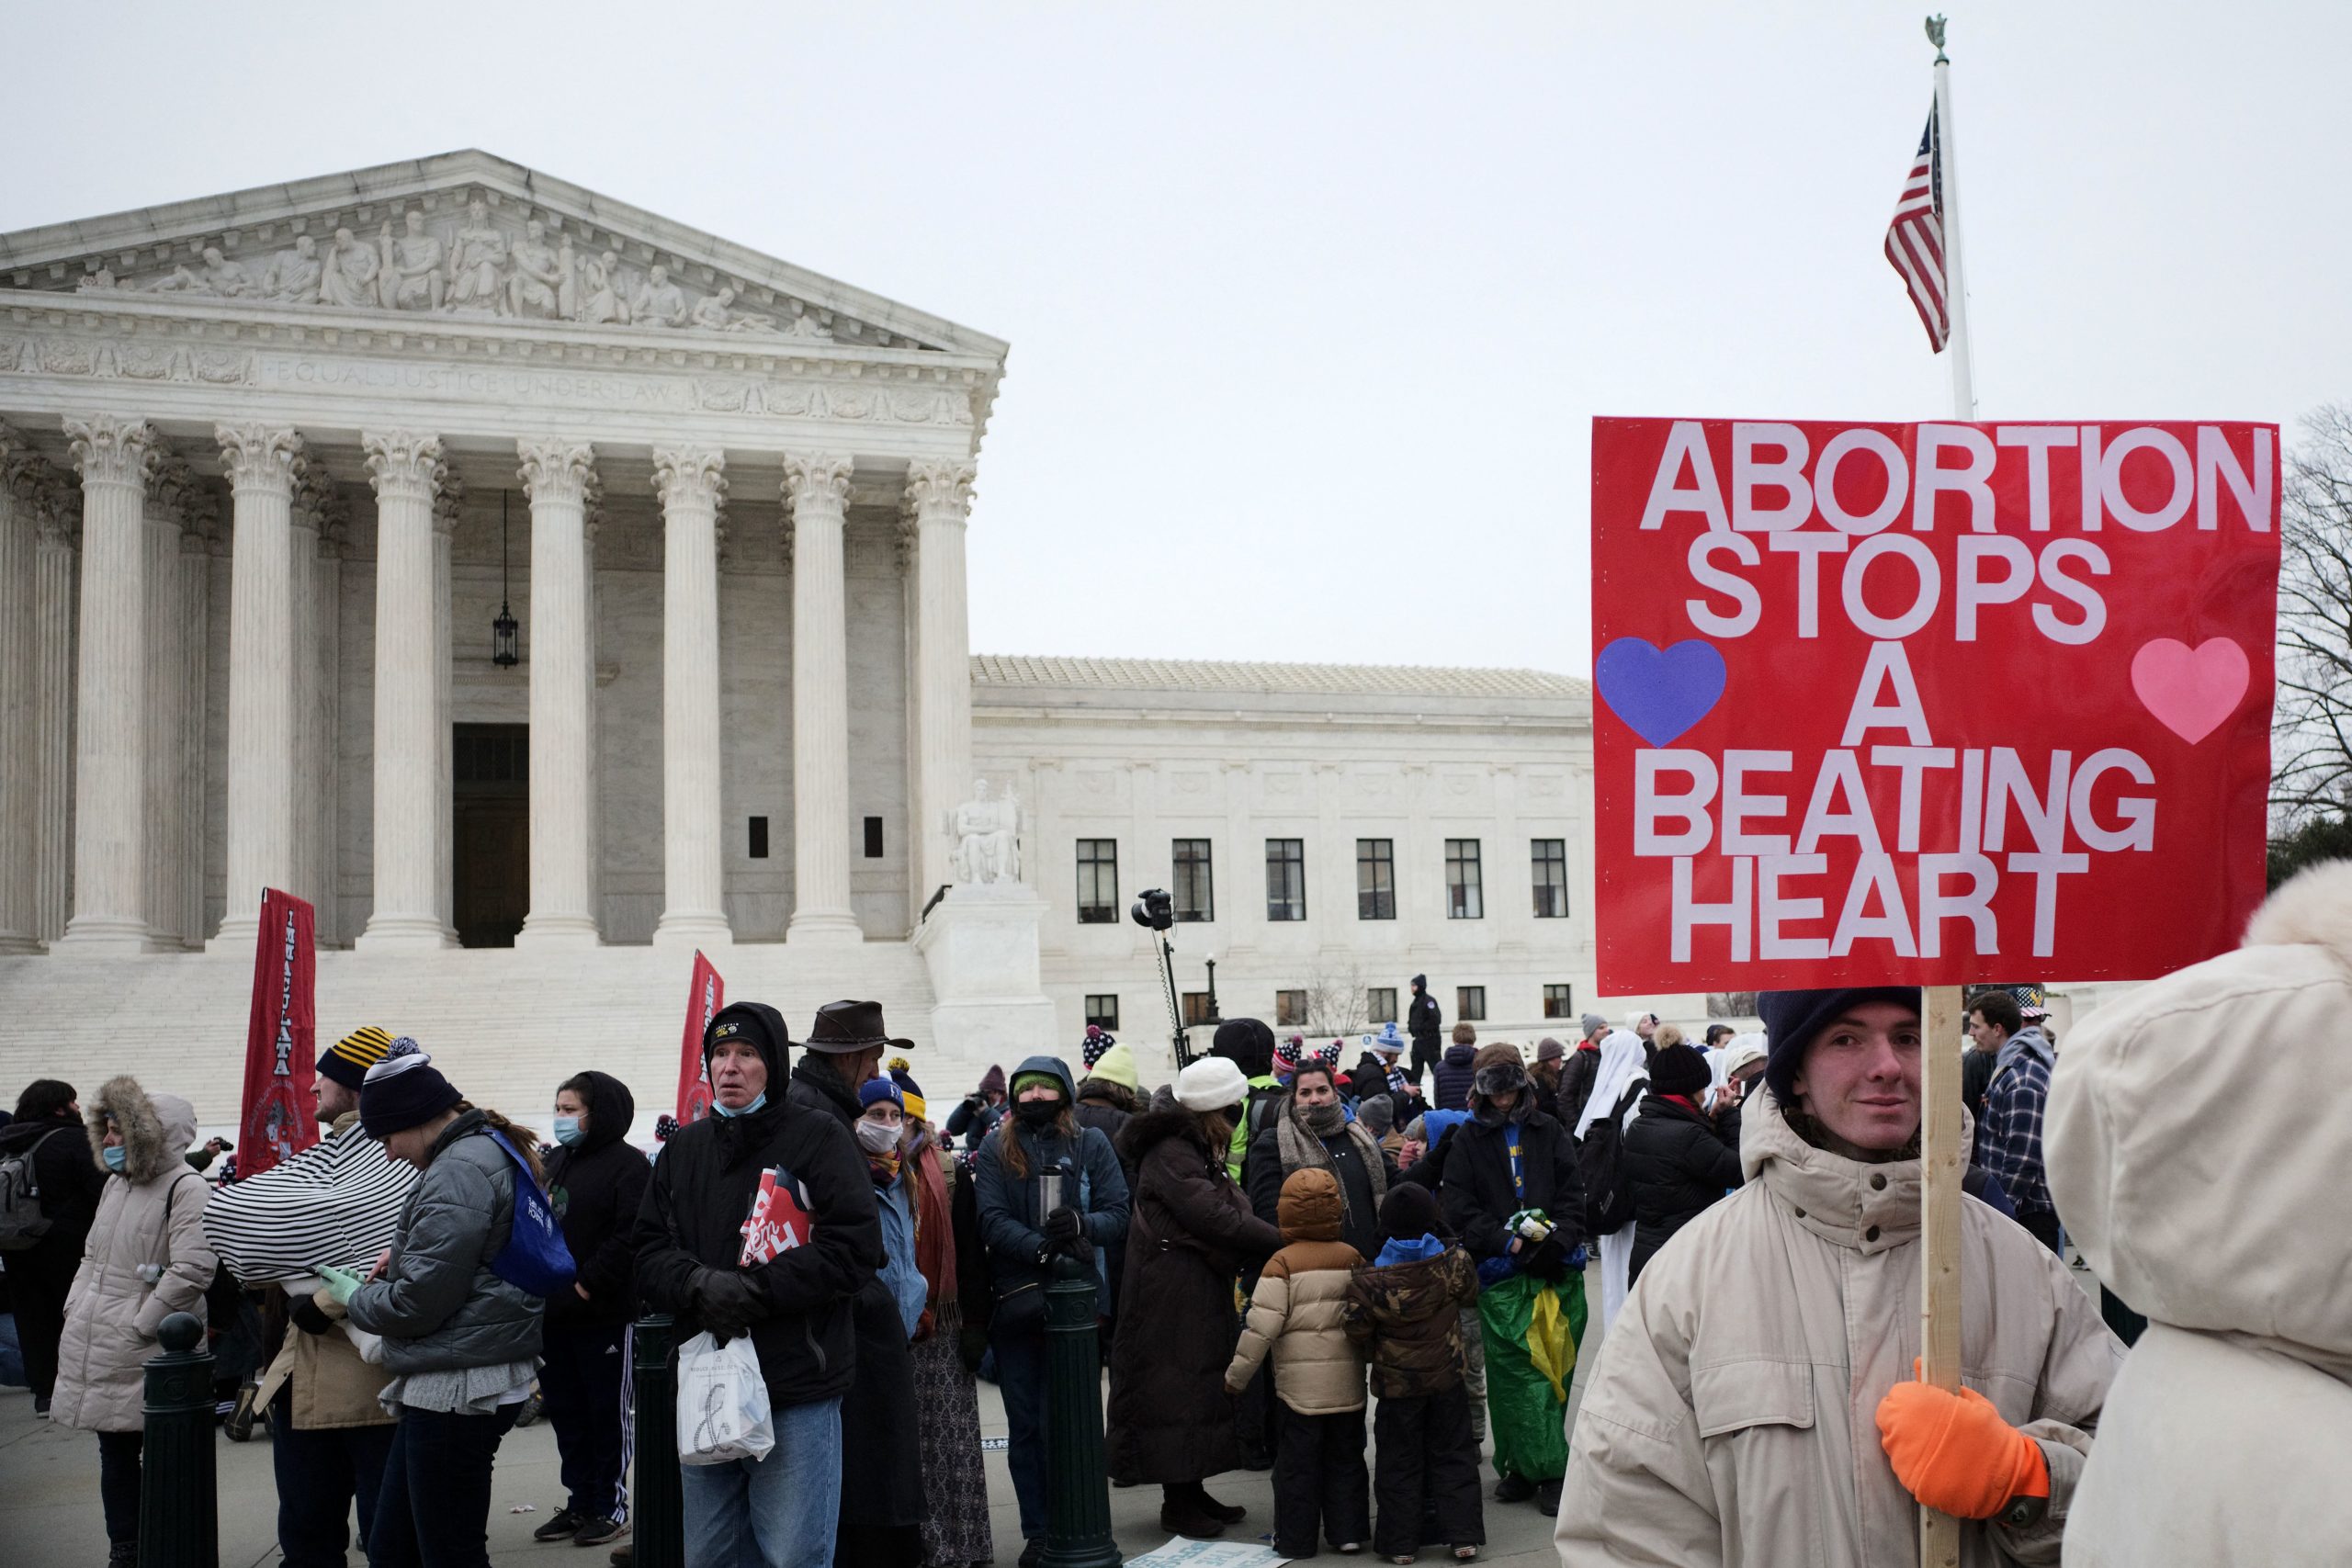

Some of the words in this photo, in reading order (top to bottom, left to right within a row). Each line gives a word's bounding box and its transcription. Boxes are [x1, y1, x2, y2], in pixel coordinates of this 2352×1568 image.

[277, 360, 378, 387] EQUAL
[385, 368, 499, 394] JUSTICE
[514, 374, 605, 399] UNDER
[617, 380, 672, 400] LAW
[1640, 421, 2272, 536] ABORTION
[1686, 531, 2111, 645] STOPS
[1840, 640, 1933, 747] A
[1634, 746, 2156, 857] BEATING
[1670, 852, 2089, 964] HEART
[273, 909, 296, 1076] IMMACULATA
